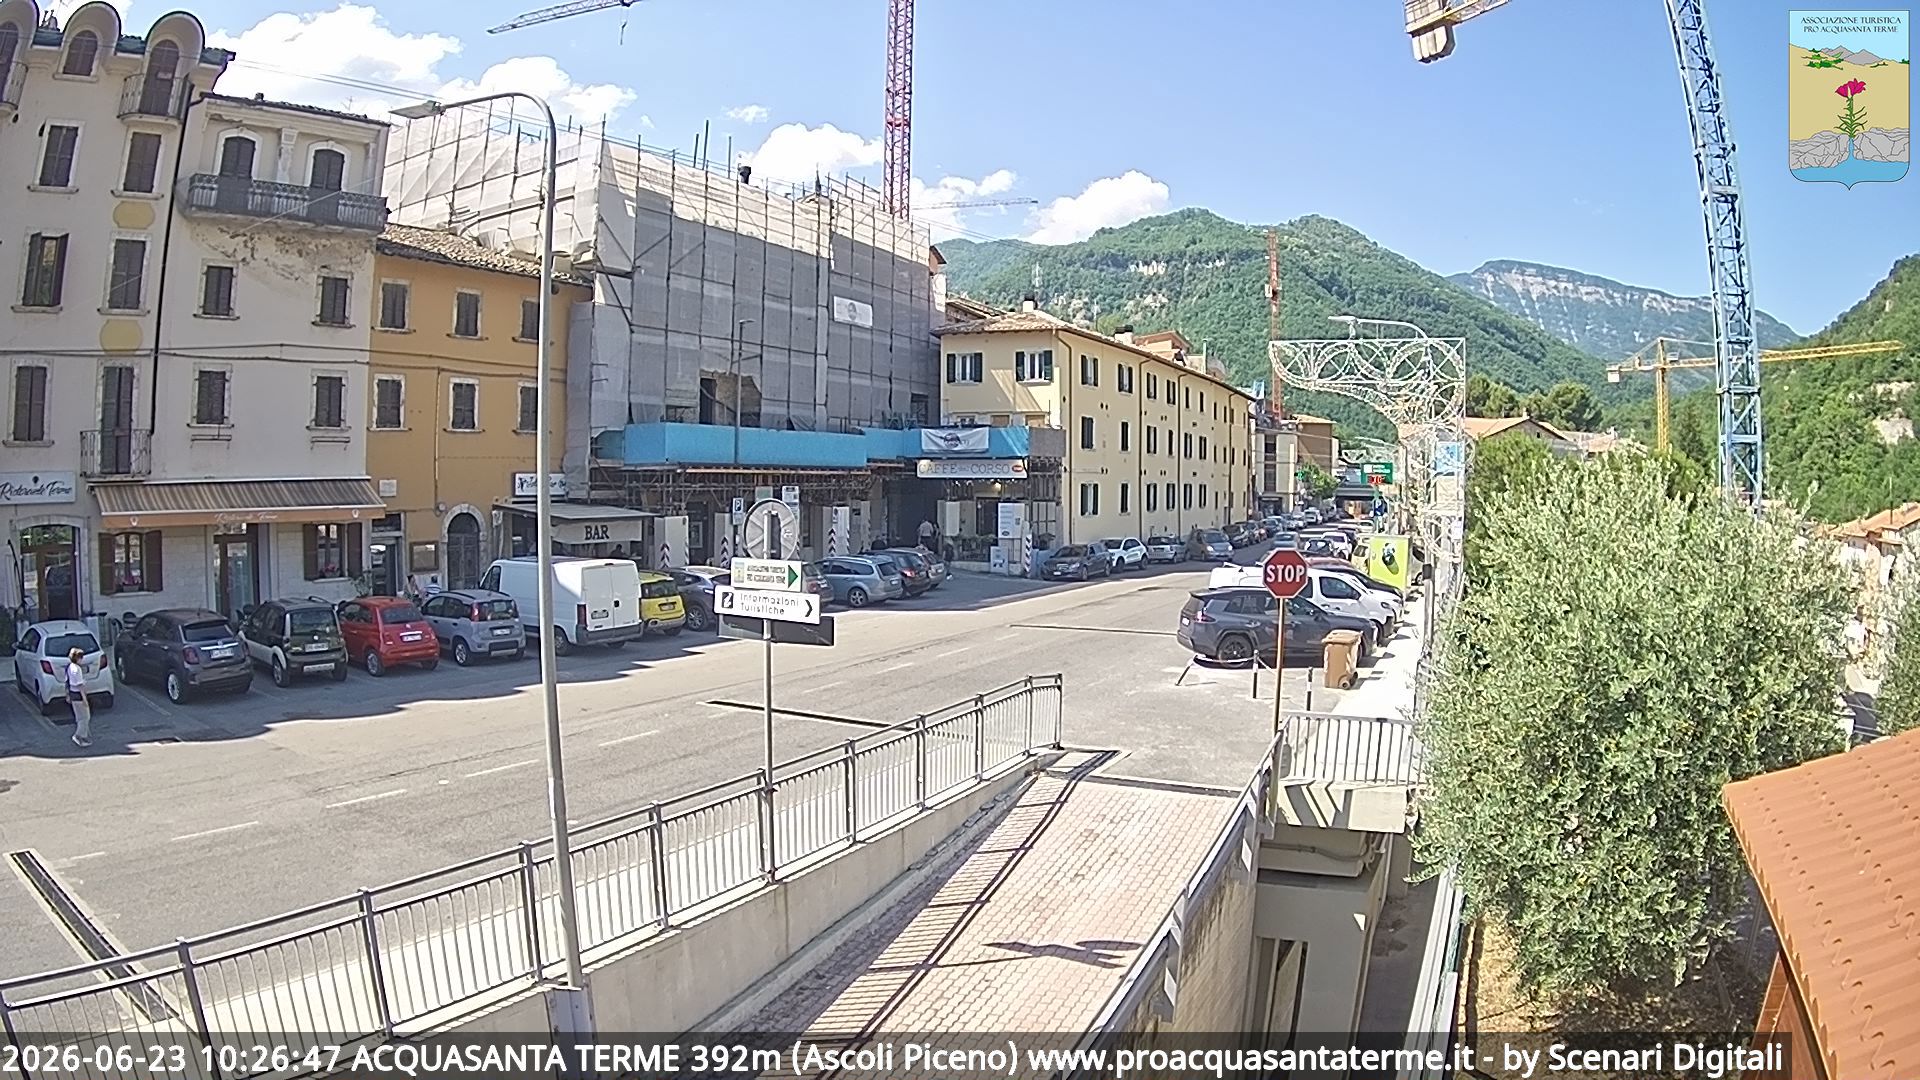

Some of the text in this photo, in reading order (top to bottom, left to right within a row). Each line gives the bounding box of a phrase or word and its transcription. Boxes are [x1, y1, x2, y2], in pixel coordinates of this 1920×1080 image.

[970, 463, 1010, 475] CORSO
[584, 524, 610, 541] BAR
[1266, 564, 1305, 583] STOP
[740, 593, 799, 607] Informazioni
[740, 602, 785, 615] Turistiche
